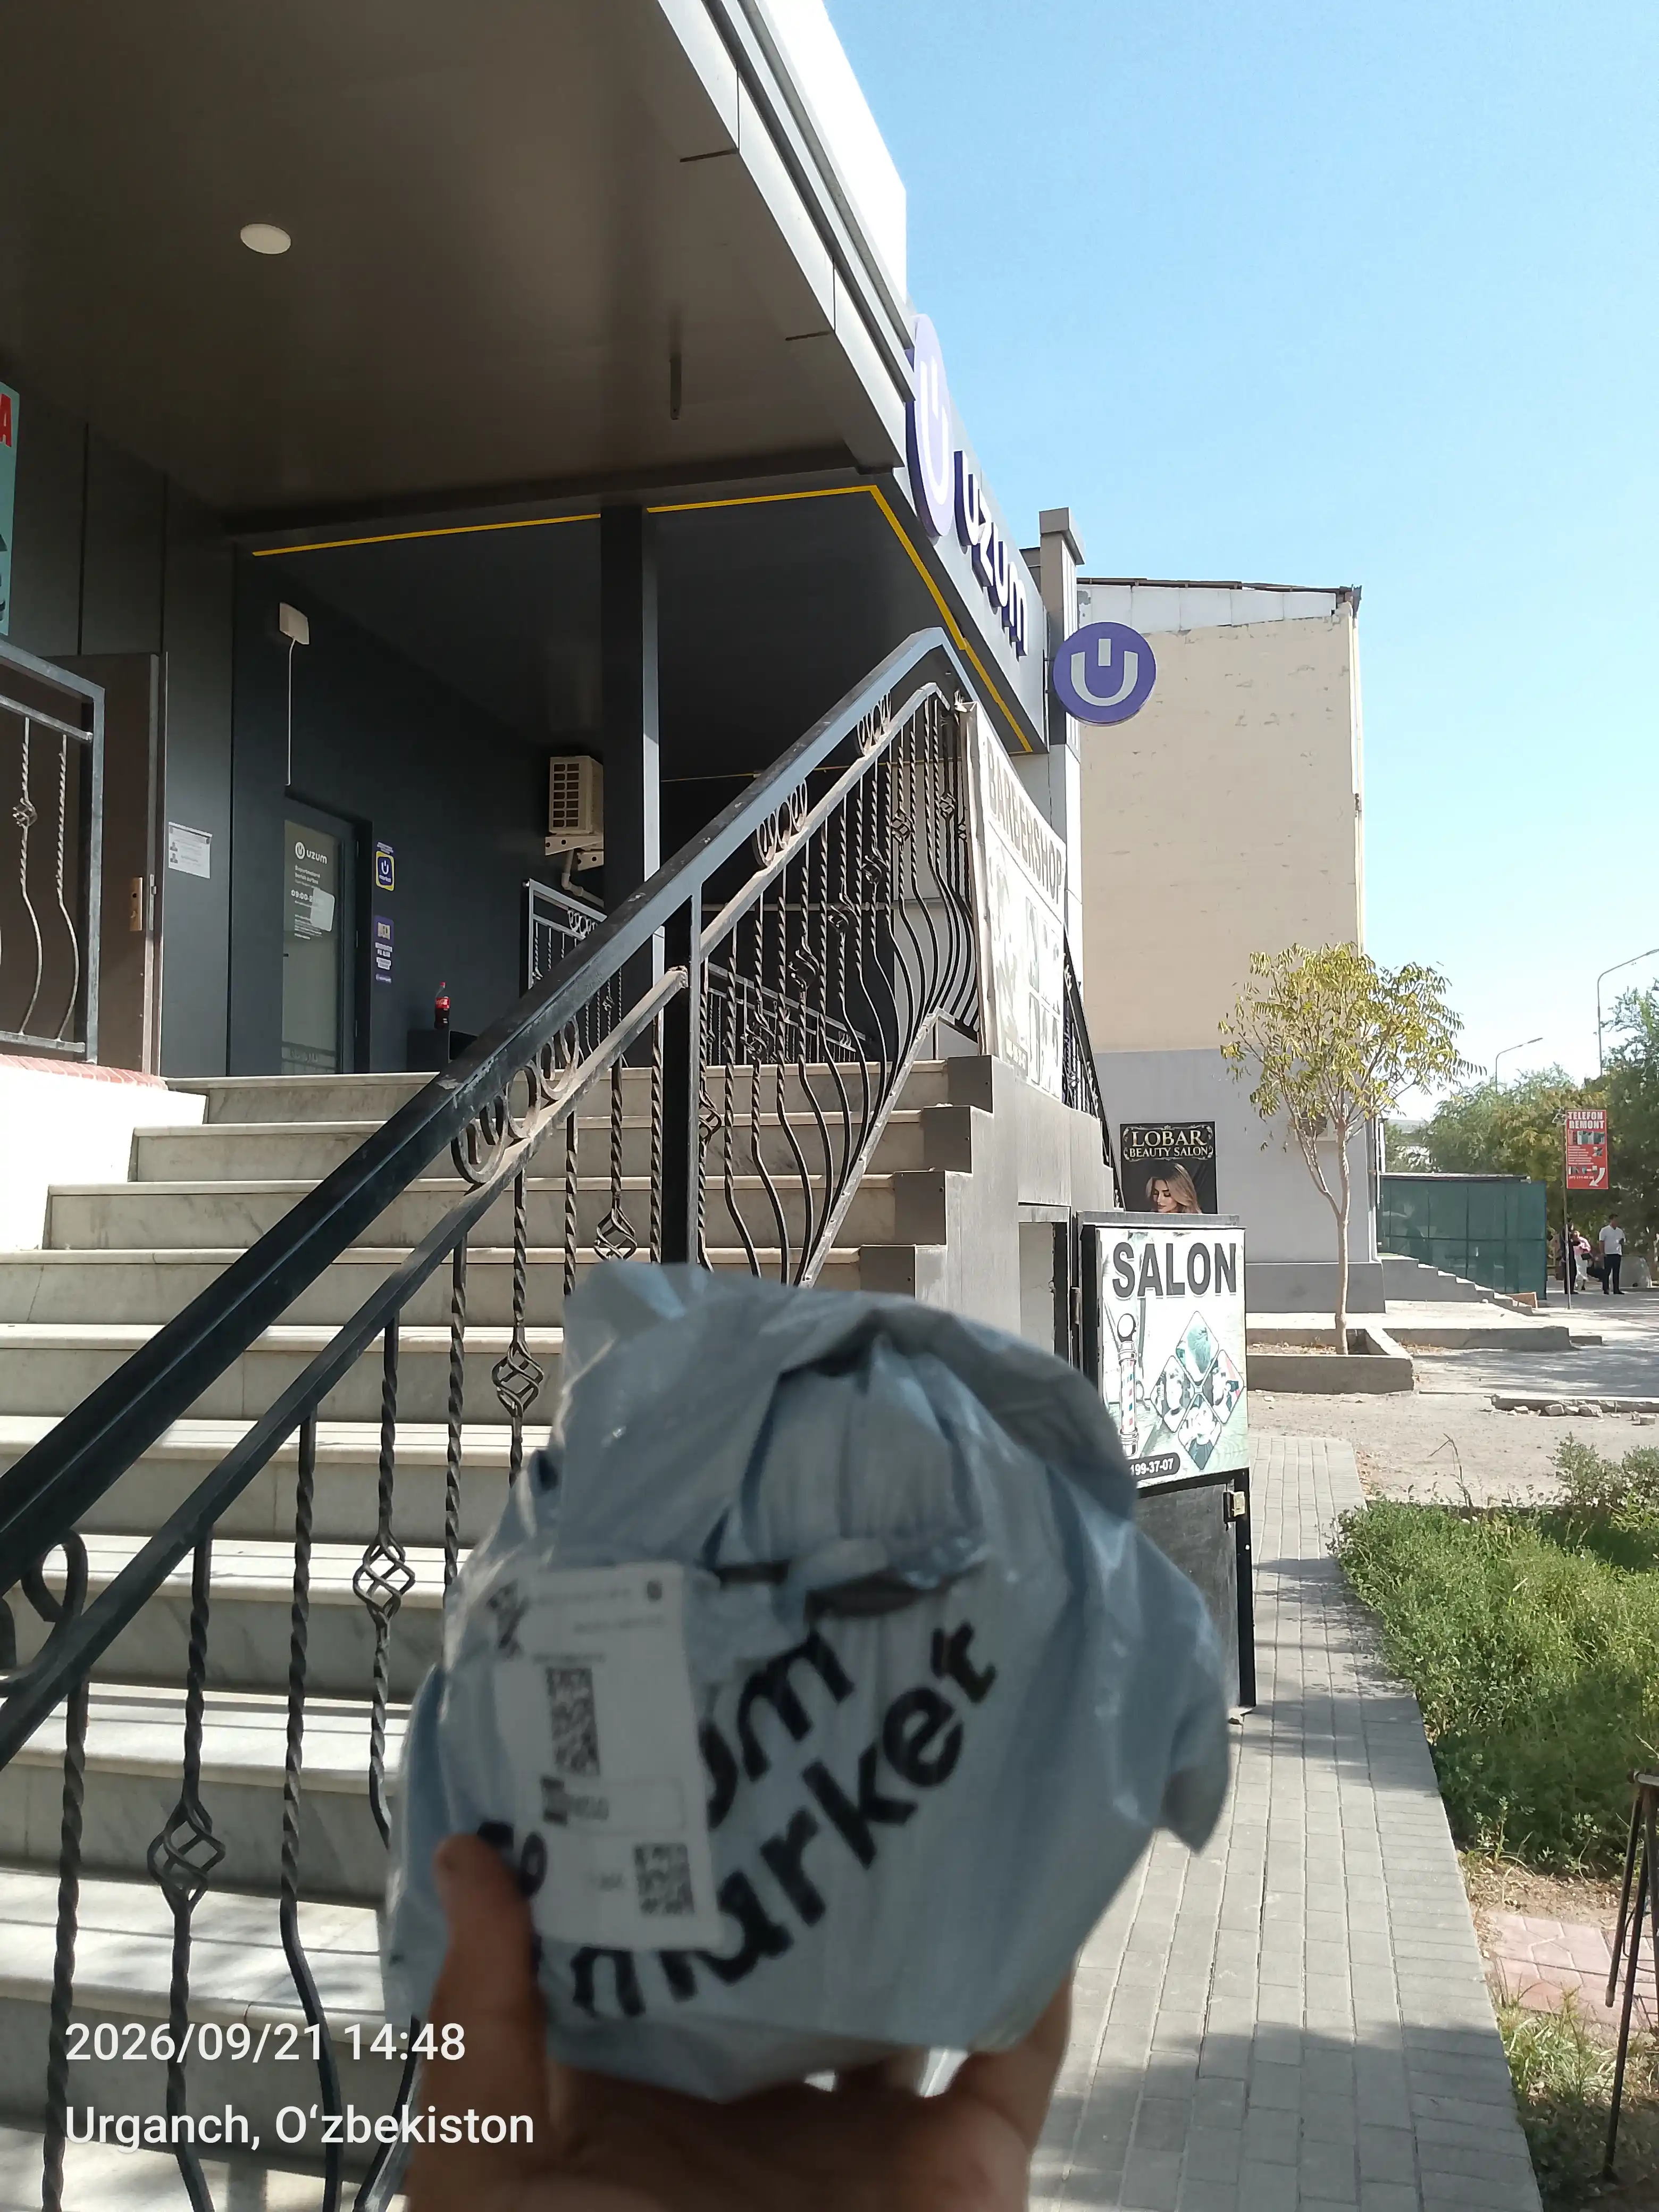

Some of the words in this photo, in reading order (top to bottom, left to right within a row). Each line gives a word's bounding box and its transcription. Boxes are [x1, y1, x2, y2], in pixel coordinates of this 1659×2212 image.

[954, 450, 1028, 657] uzum
[986, 736, 1062, 904] BARBERSHOP
[306, 849, 327, 864] uzum
[1568, 1111, 1603, 1120] TELEFON
[1569, 1120, 1604, 1129] REMONT
[1132, 1130, 1207, 1147] LOBAR
[1129, 1147, 1171, 1158] BEAUTY
[1174, 1146, 1208, 1157] SALON
[1112, 1242, 1236, 1298] SALON
